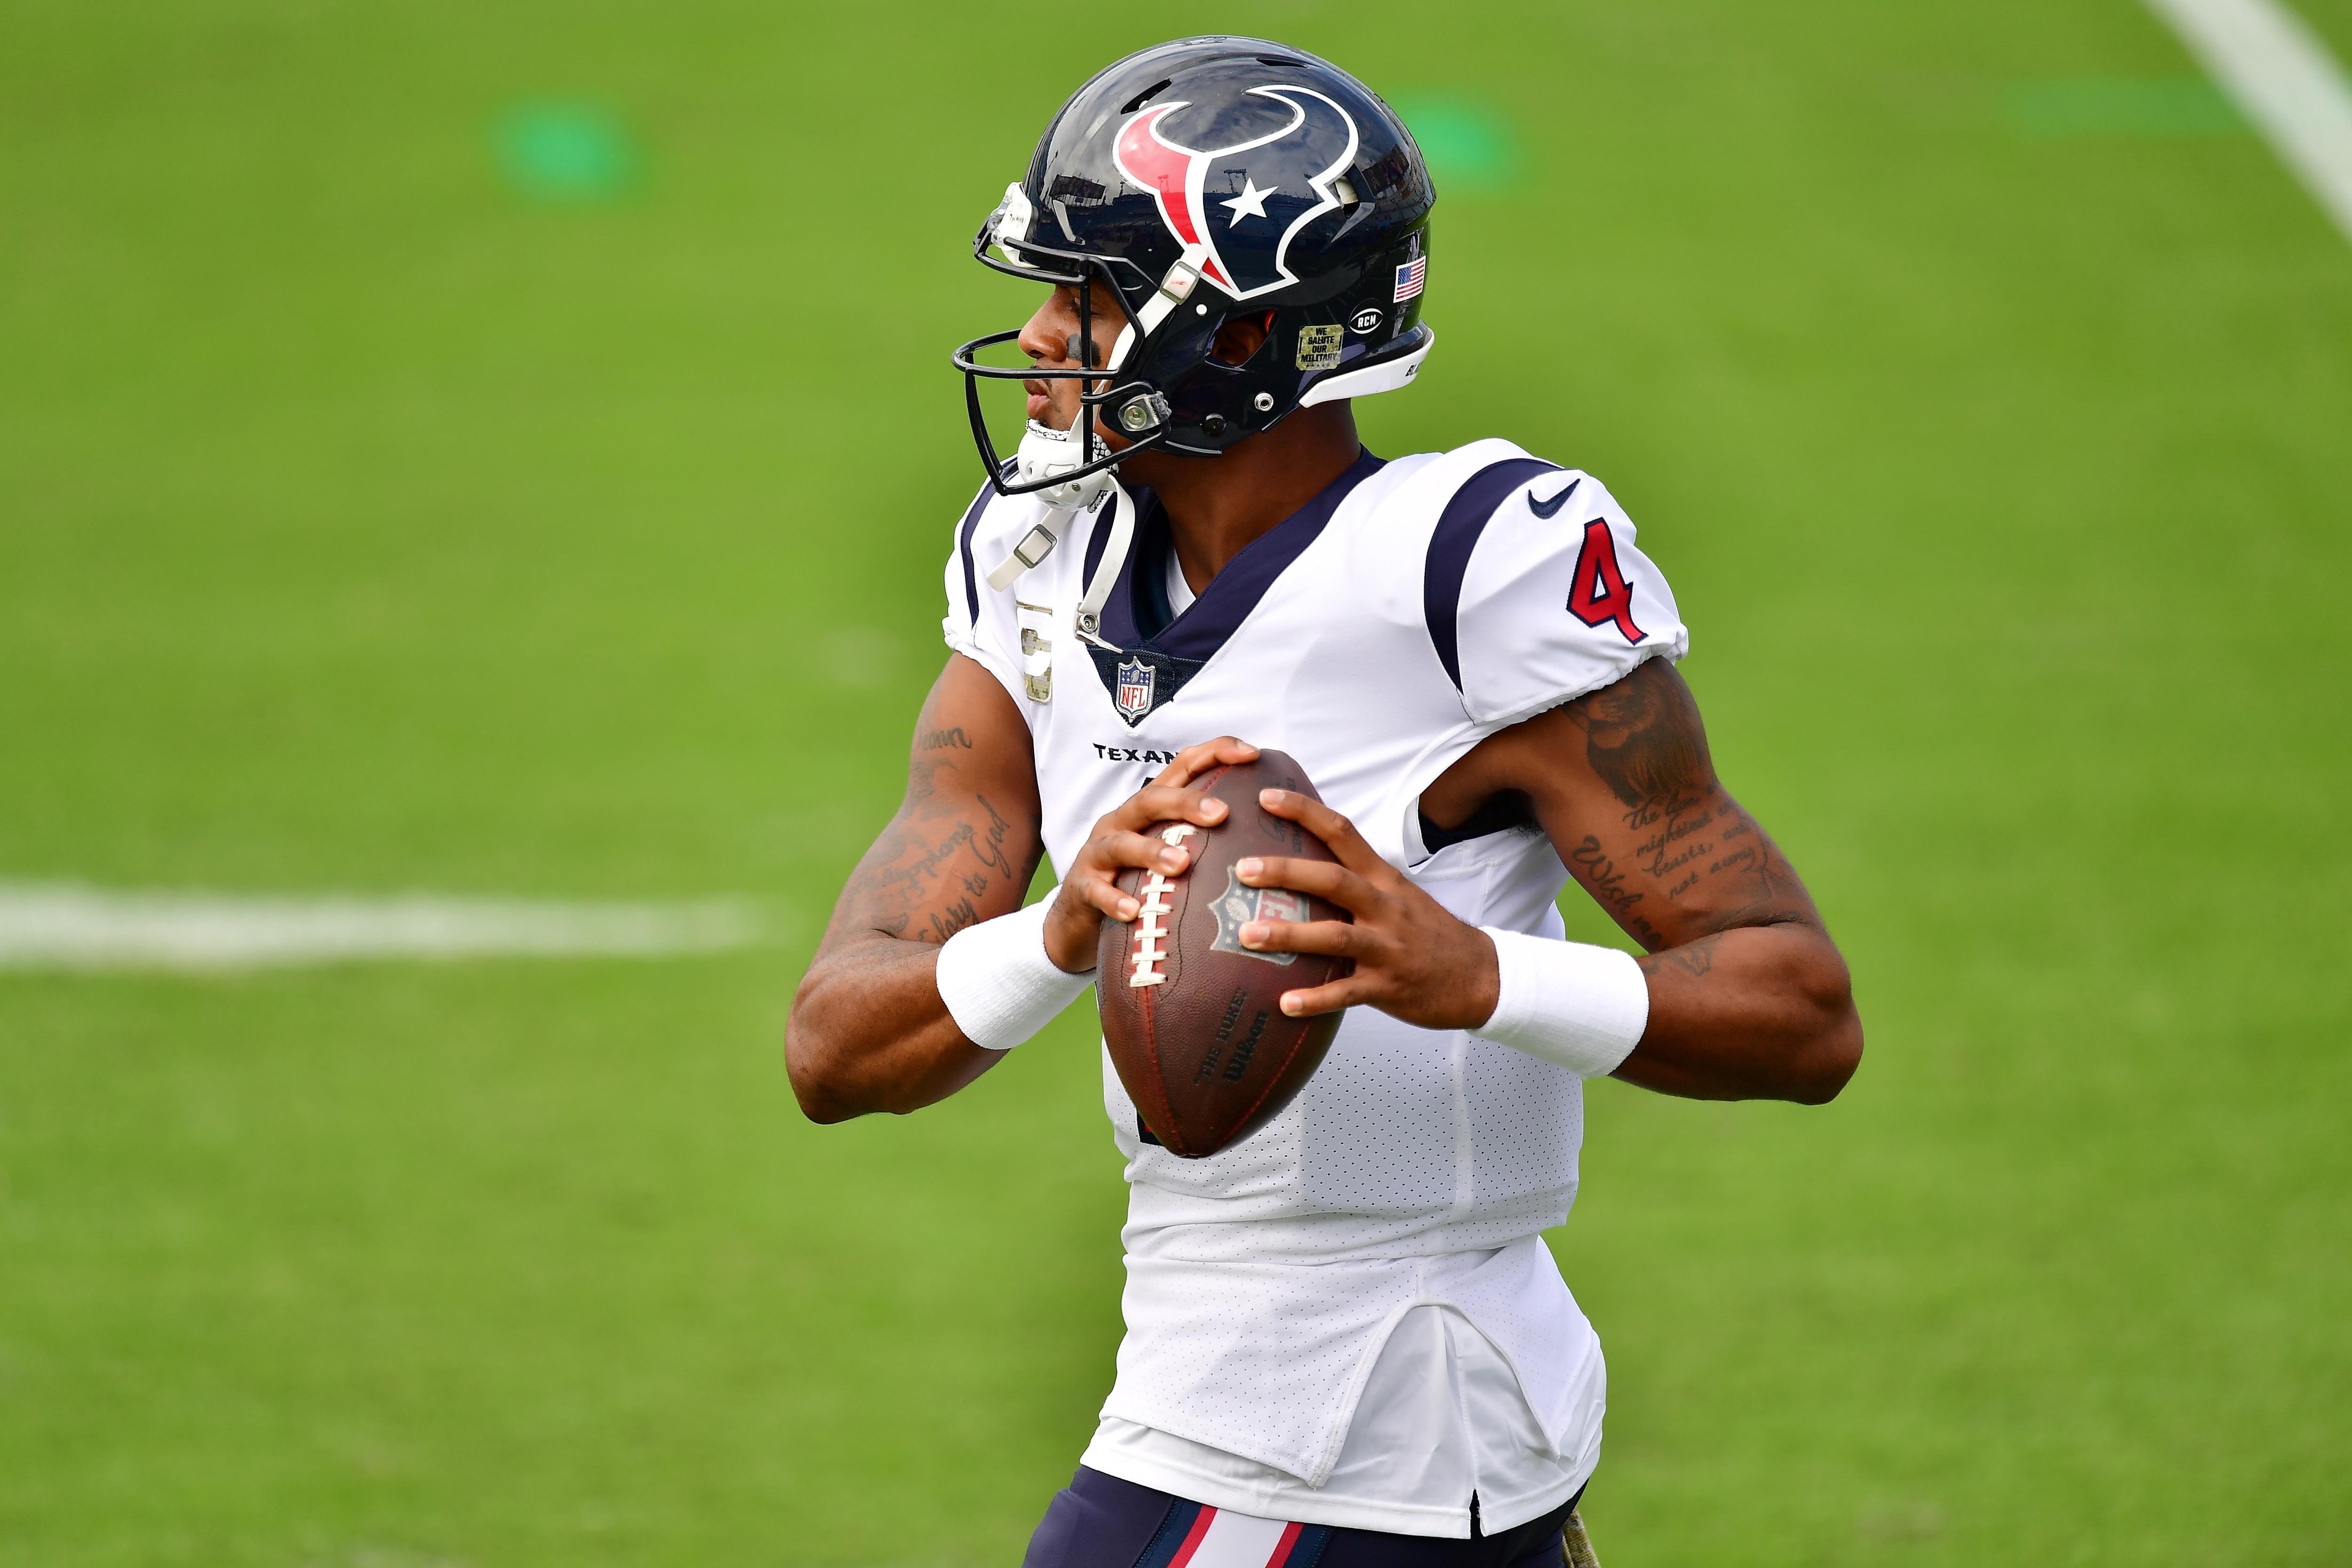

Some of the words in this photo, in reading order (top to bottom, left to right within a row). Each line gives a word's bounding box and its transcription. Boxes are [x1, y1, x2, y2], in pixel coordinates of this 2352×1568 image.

[1358, 314, 1376, 328] RCM
[1308, 335, 1335, 345] SALUTE
[1312, 345, 1327, 353] OUR
[1301, 352, 1337, 362] MILITARY
[1565, 517, 1649, 646] 4
[1121, 685, 1145, 709] NFL
[1092, 741, 1180, 765] TEXAN
